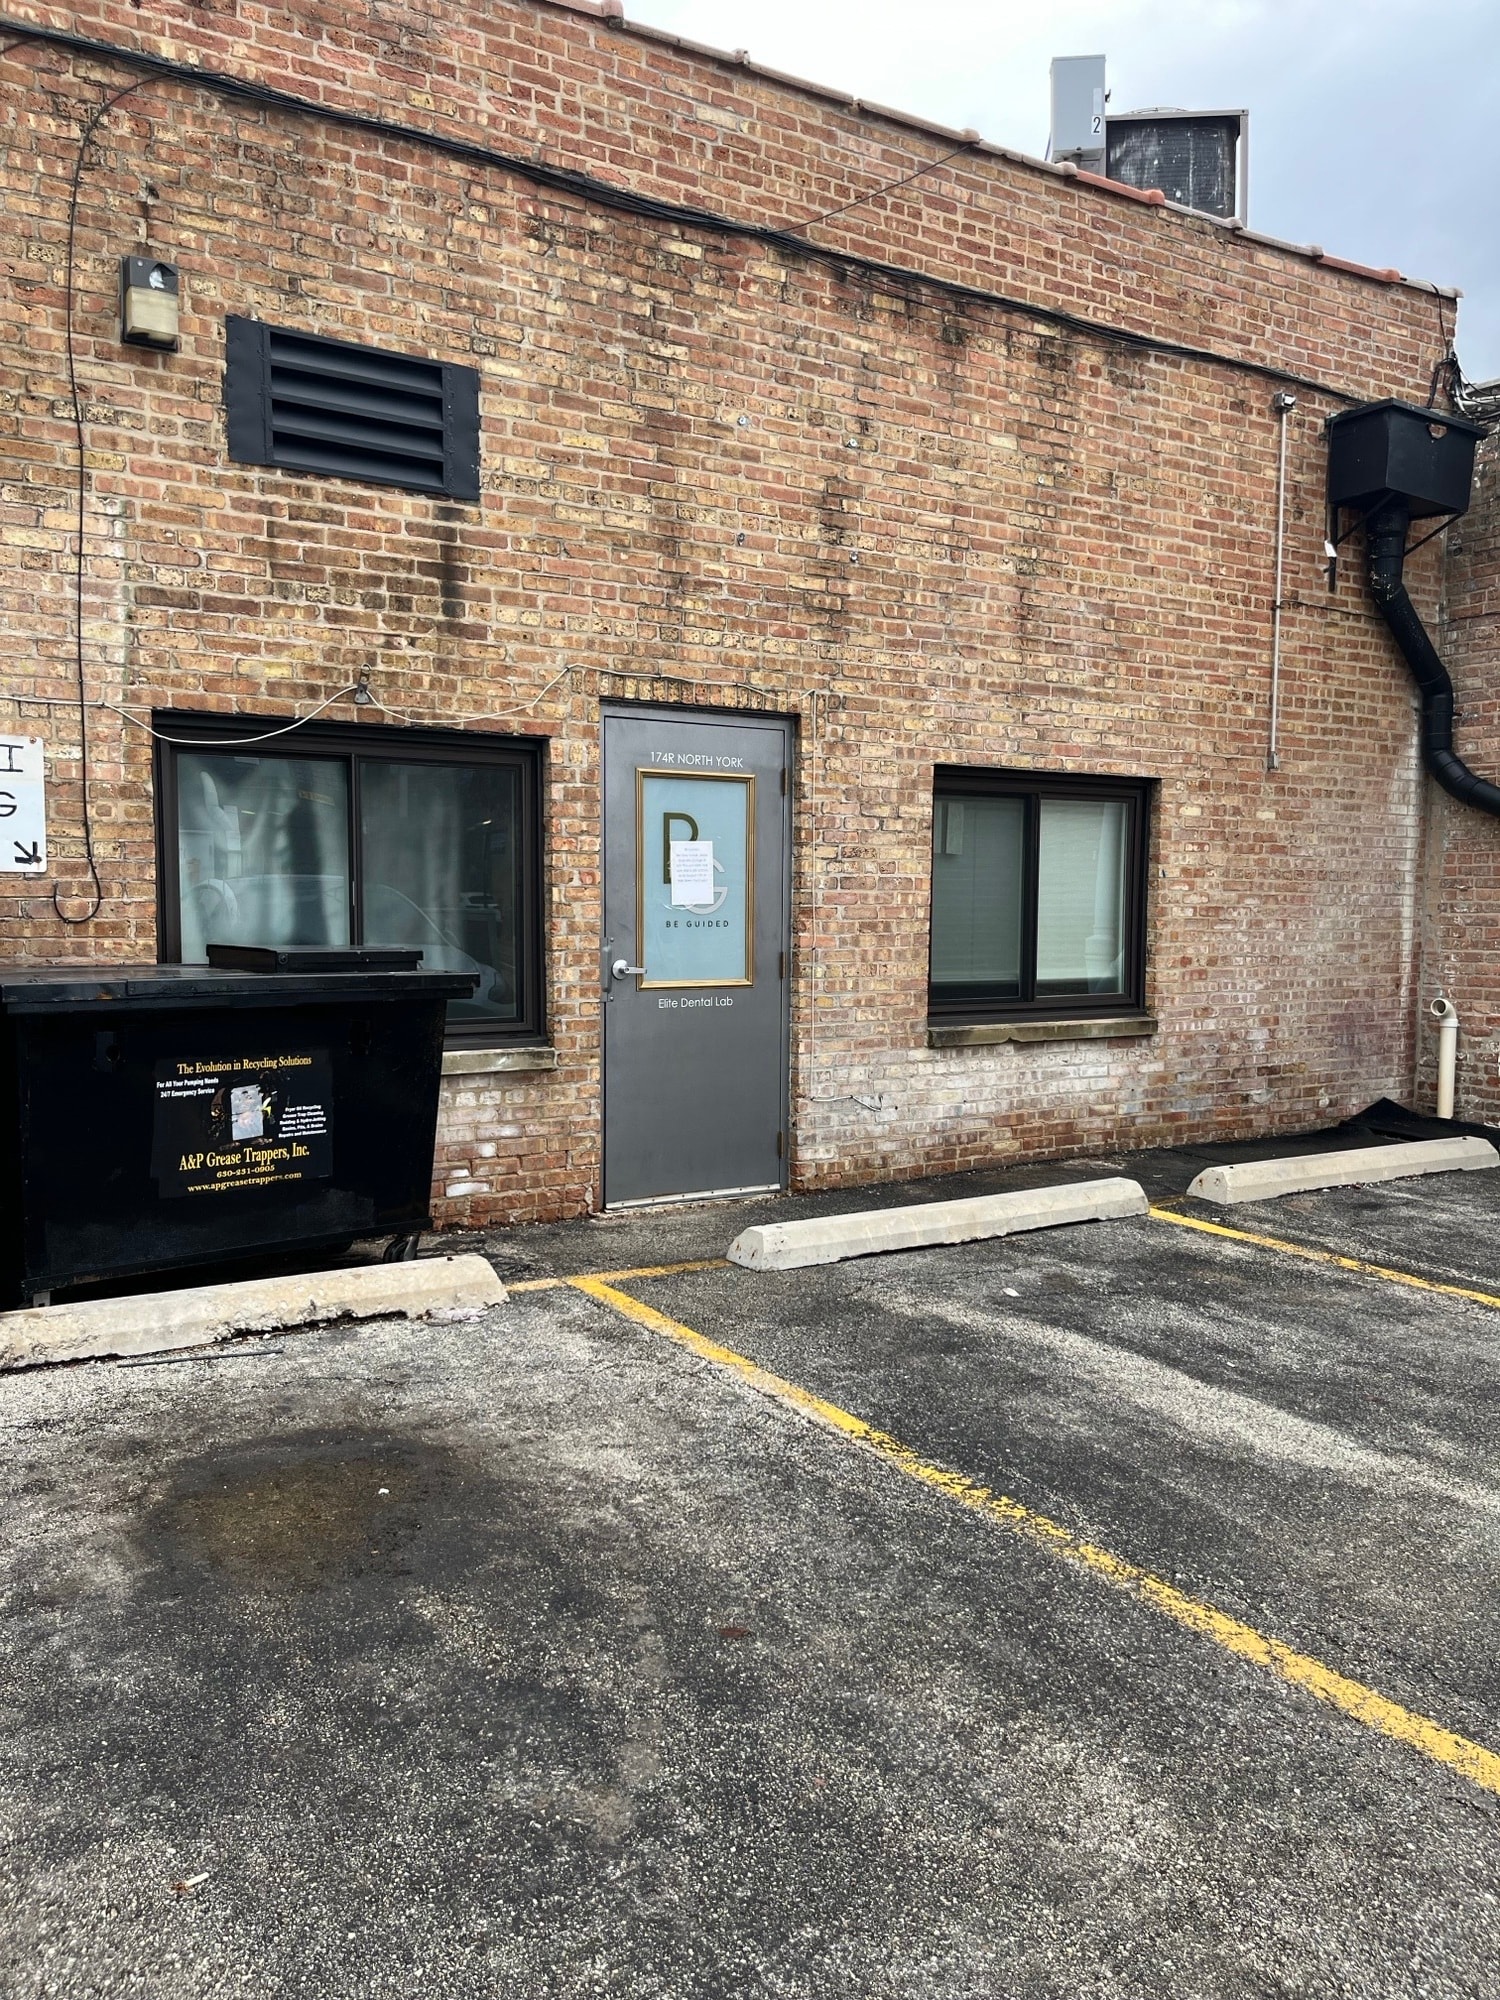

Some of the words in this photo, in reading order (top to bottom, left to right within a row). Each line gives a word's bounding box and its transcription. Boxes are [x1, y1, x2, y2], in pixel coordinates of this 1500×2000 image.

[1093, 117, 1101, 133] 2
[651, 751, 675, 764] 174R
[677, 753, 713, 767] NORTH
[715, 756, 744, 768] YORK
[665, 920, 679, 928] BE
[686, 920, 729, 928] GUIDED
[658, 998, 679, 1009] Elite
[680, 996, 713, 1008] Dental
[715, 996, 733, 1007] Lab
[177, 1063, 194, 1075] The
[195, 1060, 232, 1074] Evolution
[233, 1059, 241, 1071] in
[242, 1057, 278, 1071] Recycling
[278, 1055, 312, 1067] Solutions
[156, 1081, 165, 1089] For
[184, 1079, 204, 1087] Pumping
[160, 1090, 171, 1098] 24/7
[171, 1089, 197, 1098] Emergency
[197, 1087, 215, 1095] Service
[179, 1153, 204, 1171] A&P
[206, 1152, 241, 1168] Grease
[243, 1147, 290, 1165] Trappers,
[291, 1142, 310, 1157] Inc.
[216, 1164, 275, 1178] 630-231-0905
[187, 1171, 302, 1192] www.apgreasetrappers.com
